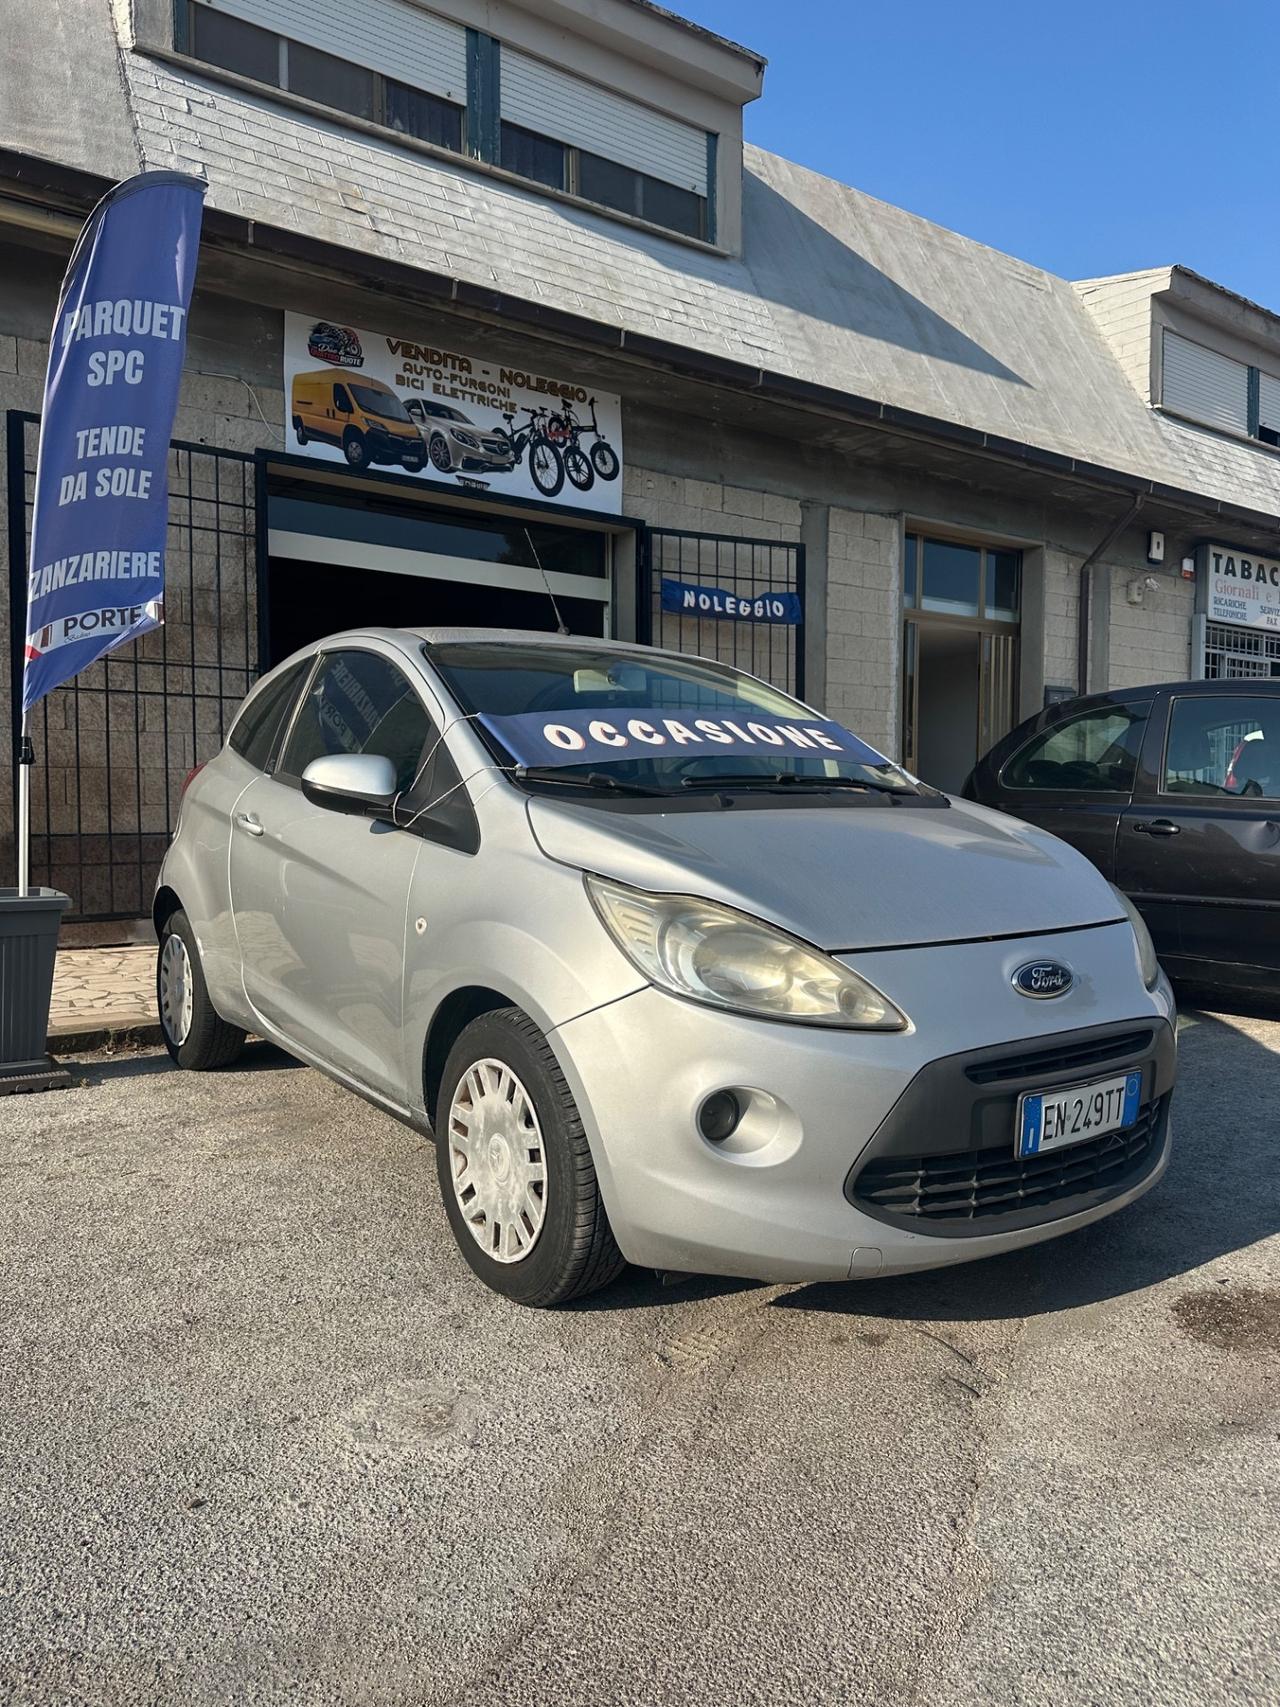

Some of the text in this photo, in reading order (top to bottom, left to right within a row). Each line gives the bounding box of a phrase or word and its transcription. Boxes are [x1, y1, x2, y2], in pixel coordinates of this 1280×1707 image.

[62, 299, 186, 348] PARQUET
[87, 350, 145, 387] SPC
[386, 337, 472, 375] VENDITA
[500, 368, 588, 404] NOLEGGIO
[403, 362, 511, 399] AUTO-FURGONI
[395, 373, 518, 415] BICI ELETTRICHE
[76, 425, 146, 460] TENDE
[59, 467, 153, 506] DA SOLE
[30, 550, 160, 601] ZANZARIERE
[1213, 552, 1280, 587] TABAC
[683, 589, 785, 618] NOLEGGIO
[1213, 596, 1247, 610] RICARICHE
[1215, 578, 1260, 601] Giornali
[64, 606, 142, 637] PORTE
[1213, 607, 1247, 622] TELEFONICHE
[542, 719, 845, 752] OCCASIONE
[1031, 966, 1067, 989] Ford
[1043, 1101, 1067, 1141] EN
[1071, 1086, 1125, 1134] 249TT
